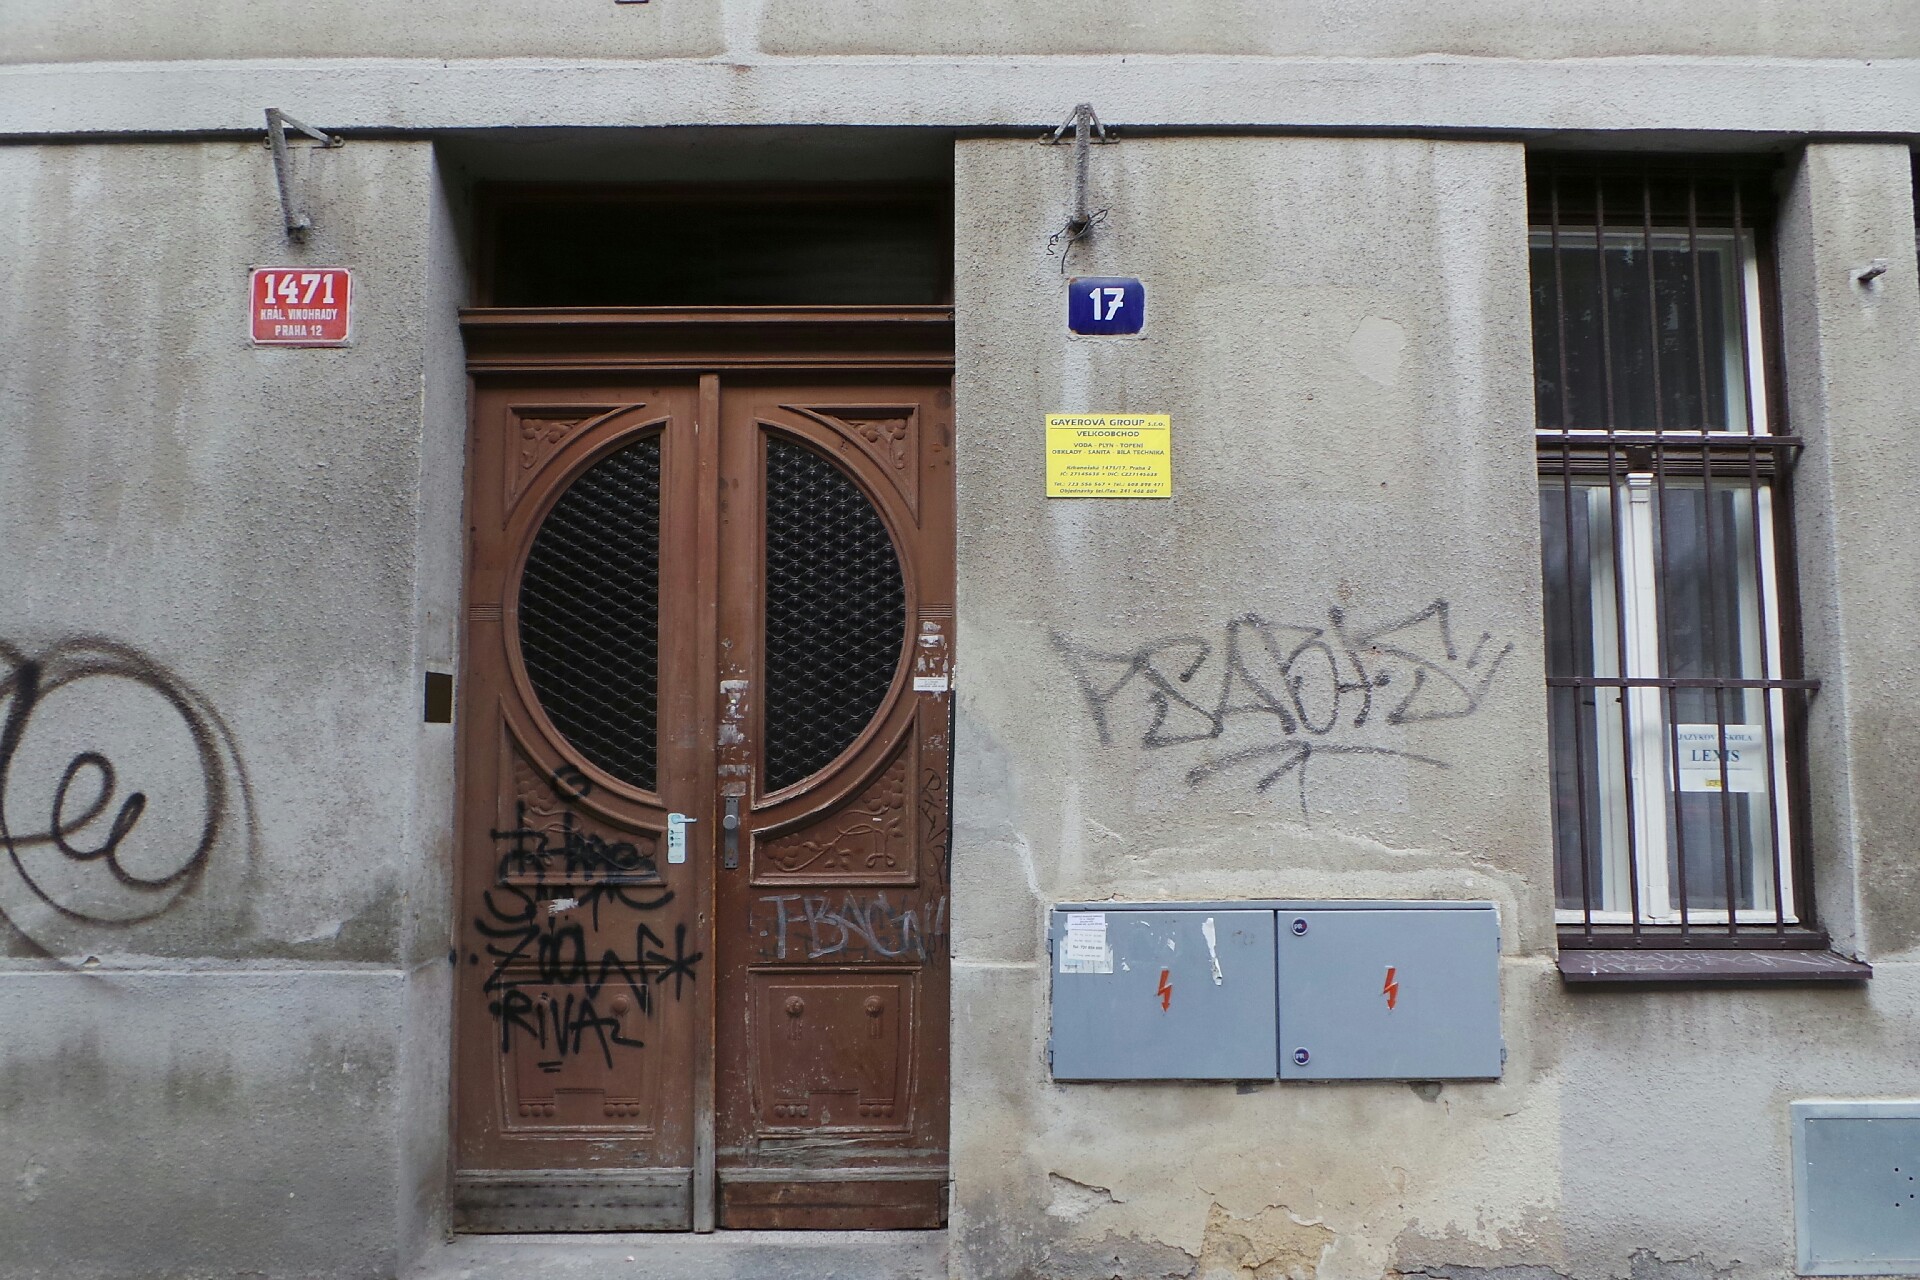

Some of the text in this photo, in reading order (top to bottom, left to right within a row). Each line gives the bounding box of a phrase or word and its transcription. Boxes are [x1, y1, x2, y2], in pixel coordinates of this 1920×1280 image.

[264, 273, 335, 304] 1471
[1089, 287, 1125, 321] 17
[288, 308, 338, 320] VINOHRADY
[274, 324, 322, 336] PRAHA 12
[1050, 418, 1106, 426] GAYEROVÁ
